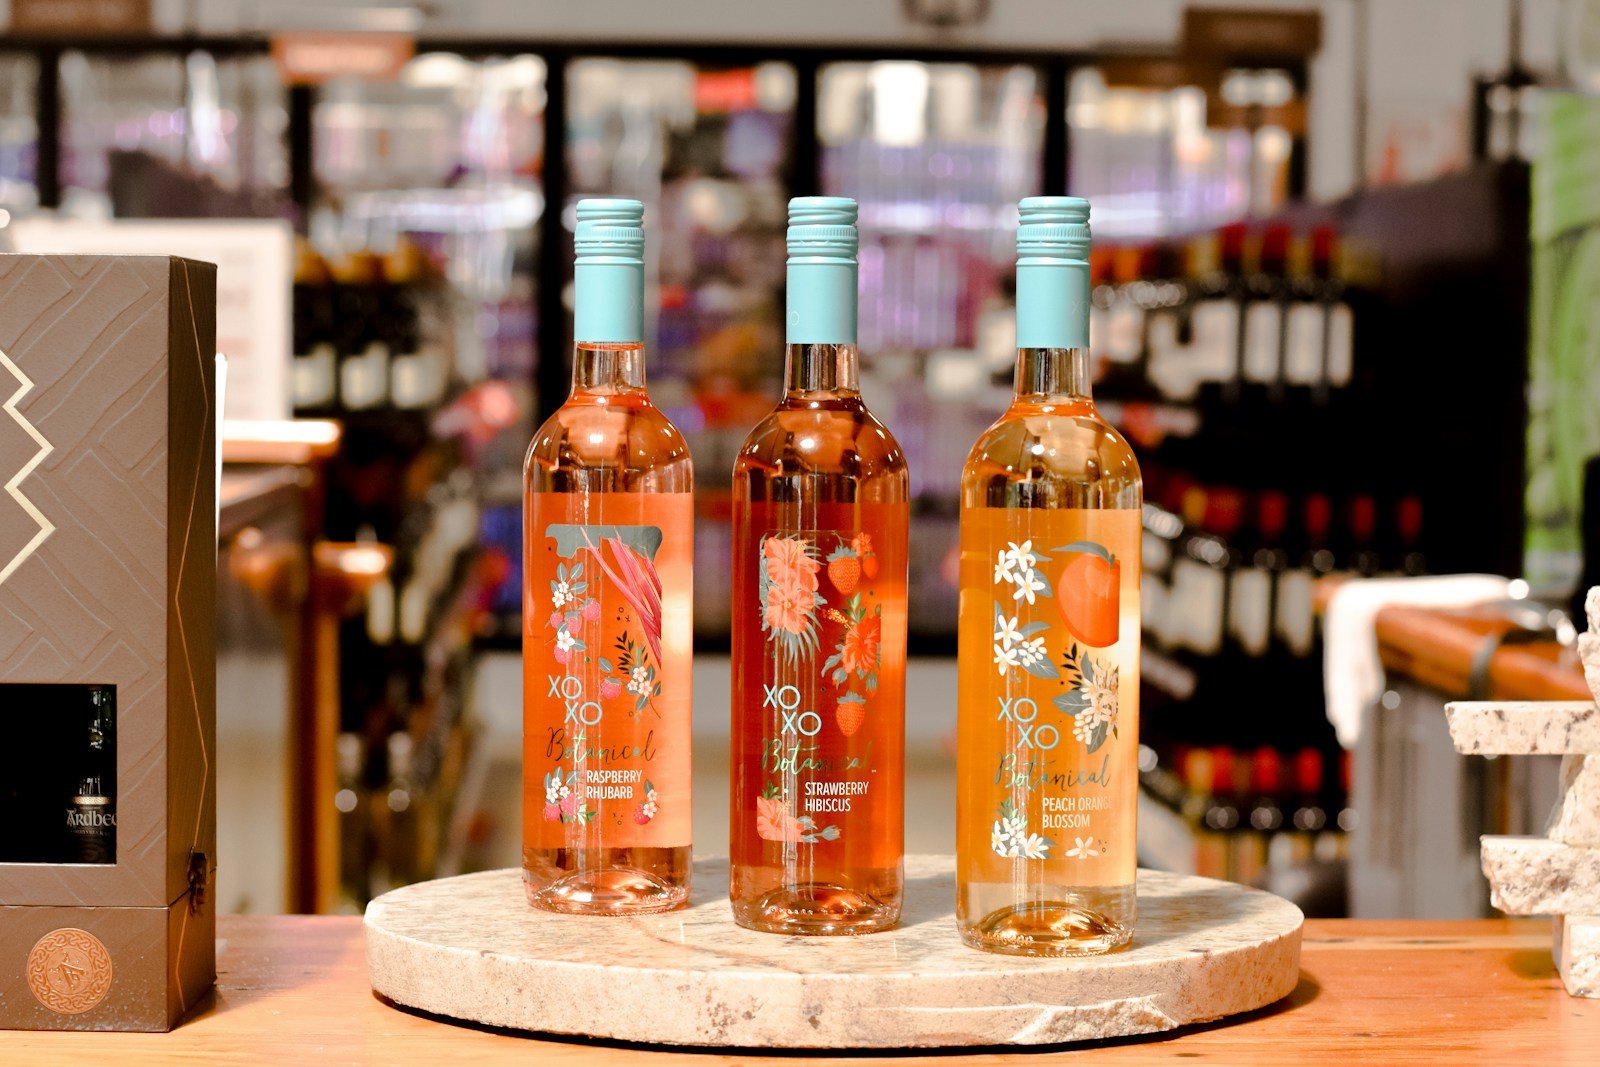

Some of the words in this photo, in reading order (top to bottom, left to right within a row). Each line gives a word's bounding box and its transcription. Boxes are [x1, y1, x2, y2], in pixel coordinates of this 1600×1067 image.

[548, 675, 582, 700] XO
[763, 684, 801, 710] XO
[564, 701, 603, 725] XO
[997, 697, 1038, 723] XO
[781, 711, 822, 736] XO
[547, 727, 657, 763] Botanical
[1017, 724, 1059, 750] XO
[586, 770, 643, 784] RASPBERRY
[994, 752, 1111, 791] Botanical
[586, 786, 634, 799] RHUBARB
[805, 782, 870, 796] STRAWBERRY
[805, 798, 852, 812] HIBISCUS
[1042, 797, 1076, 812] PEACH
[1042, 814, 1090, 829] BLOSSOM
